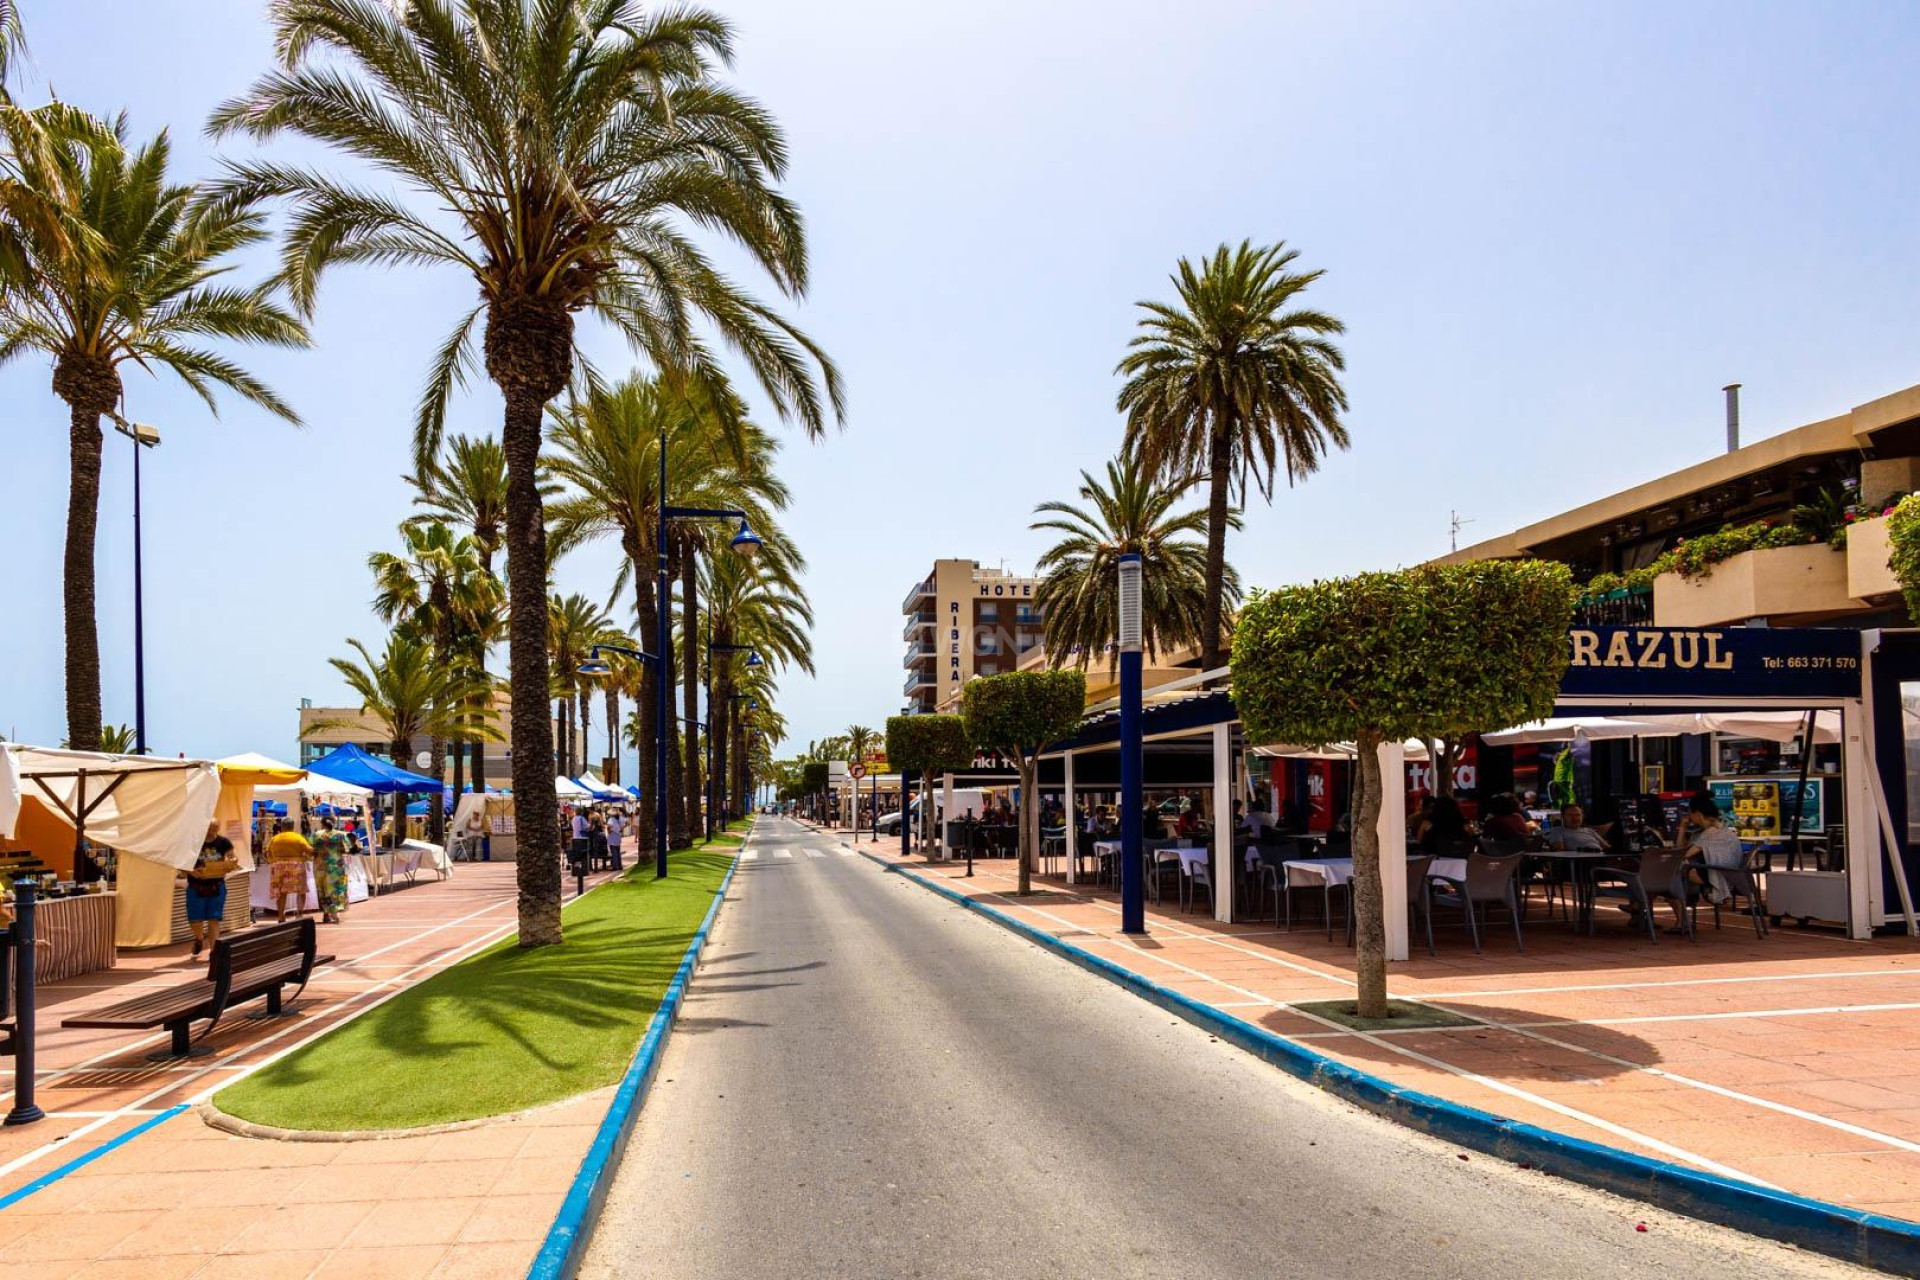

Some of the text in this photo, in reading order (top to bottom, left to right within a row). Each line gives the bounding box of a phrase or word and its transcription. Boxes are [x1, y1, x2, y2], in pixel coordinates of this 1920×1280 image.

[950, 601, 960, 682] RIBERA
[1762, 657, 1856, 668] Tel: 663 371 570
